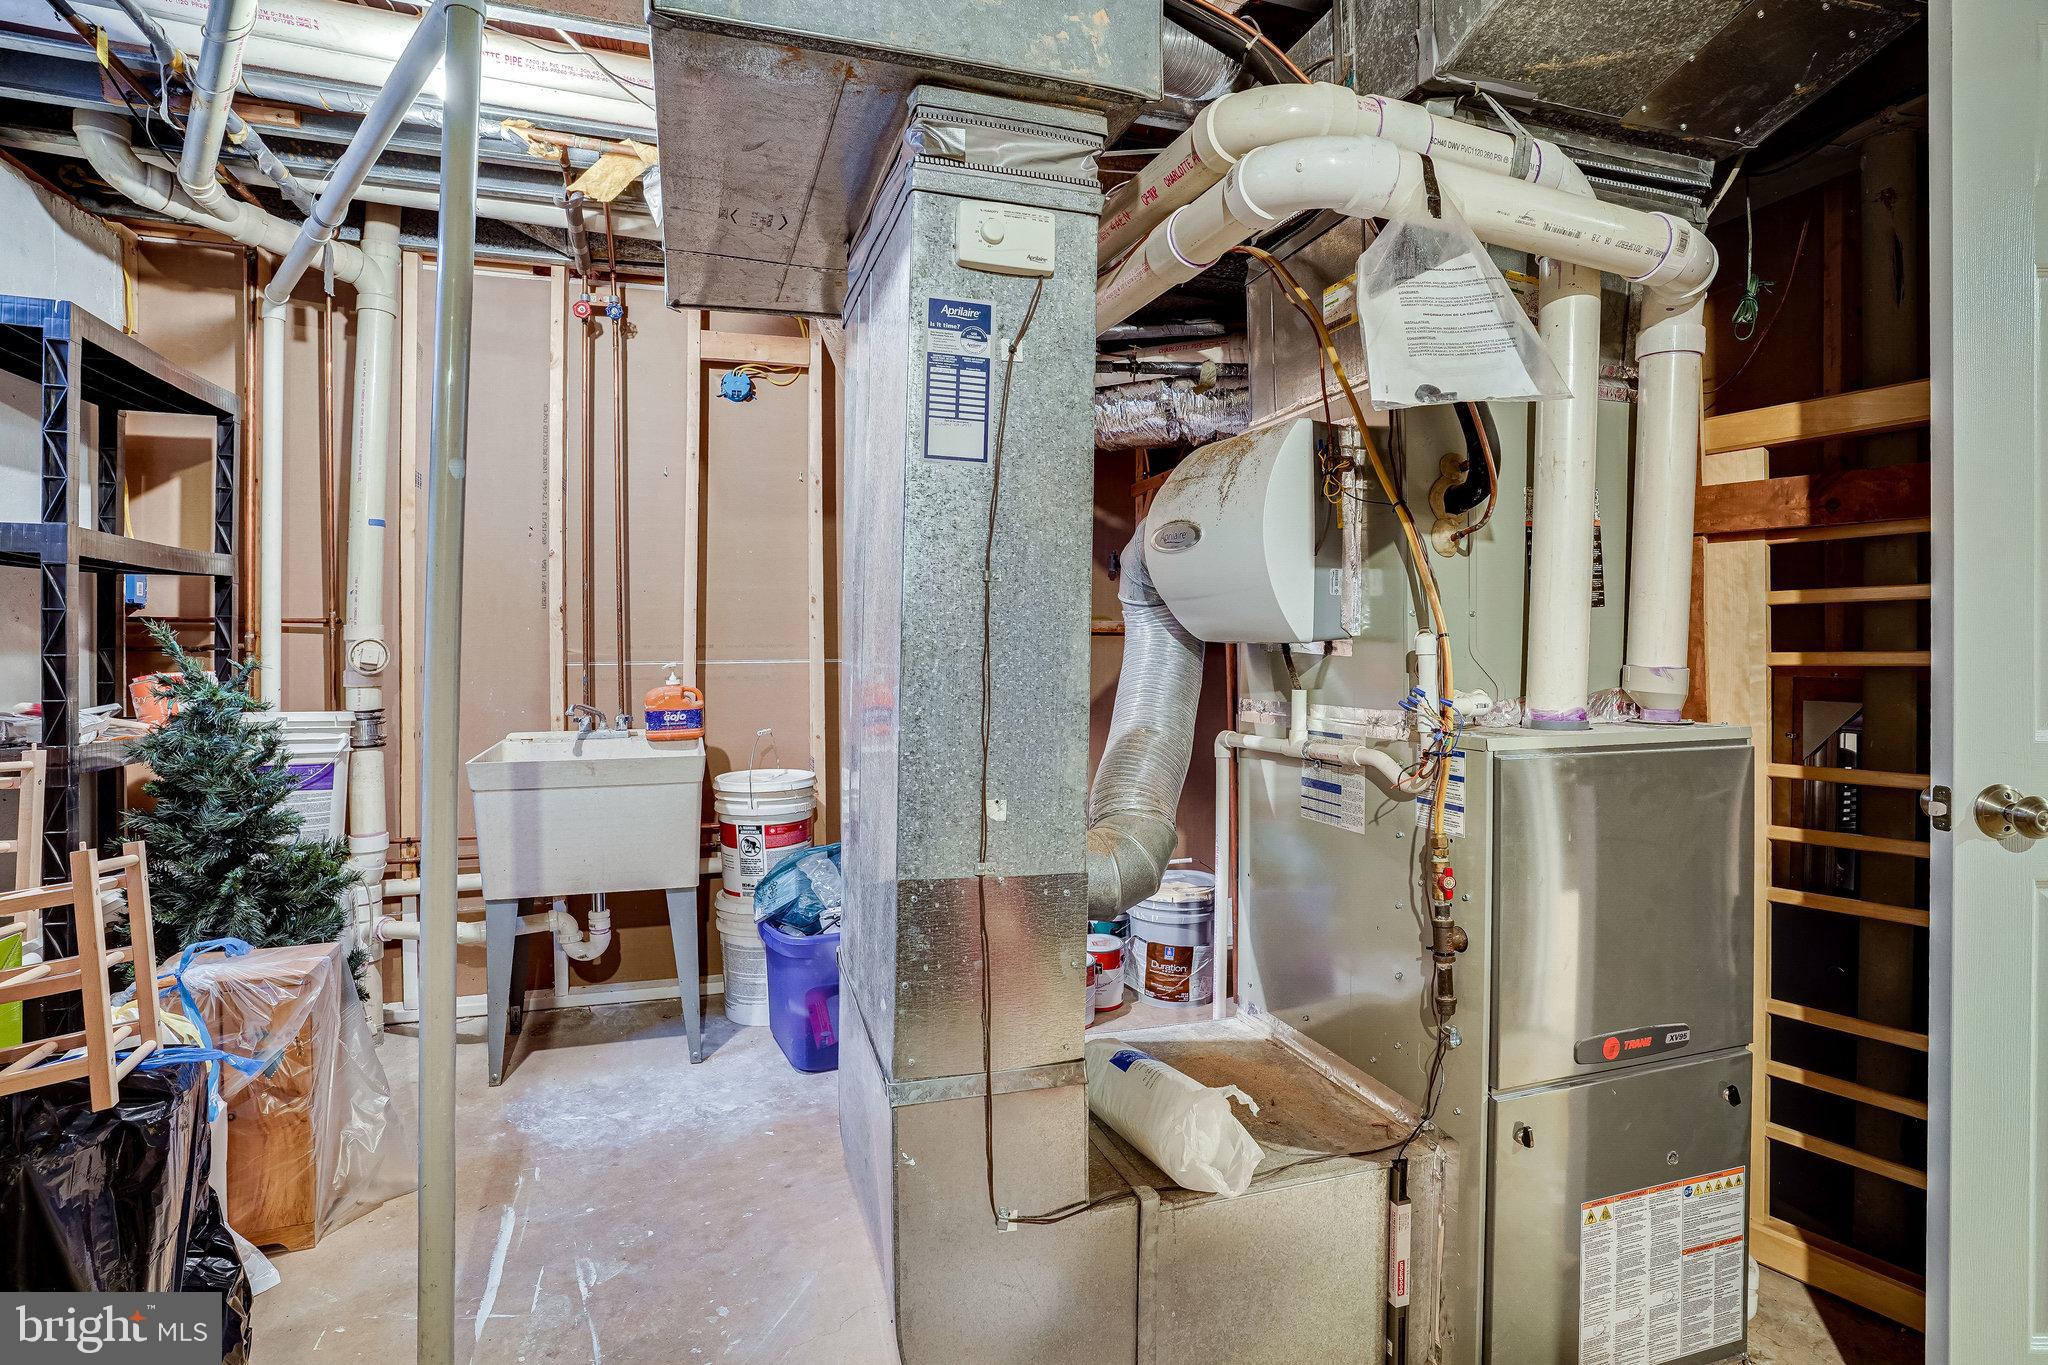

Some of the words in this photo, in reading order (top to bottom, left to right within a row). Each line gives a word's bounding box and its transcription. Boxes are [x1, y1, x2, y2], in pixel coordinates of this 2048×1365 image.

[505, 54, 523, 67] PIPE
[1163, 158, 1194, 188] CHARLOTTE
[940, 304, 981, 318] Aprilaire
[1150, 959, 1187, 973] Duration
[1624, 1036, 1653, 1050] TRANE
[1669, 1032, 1688, 1043] XV95
